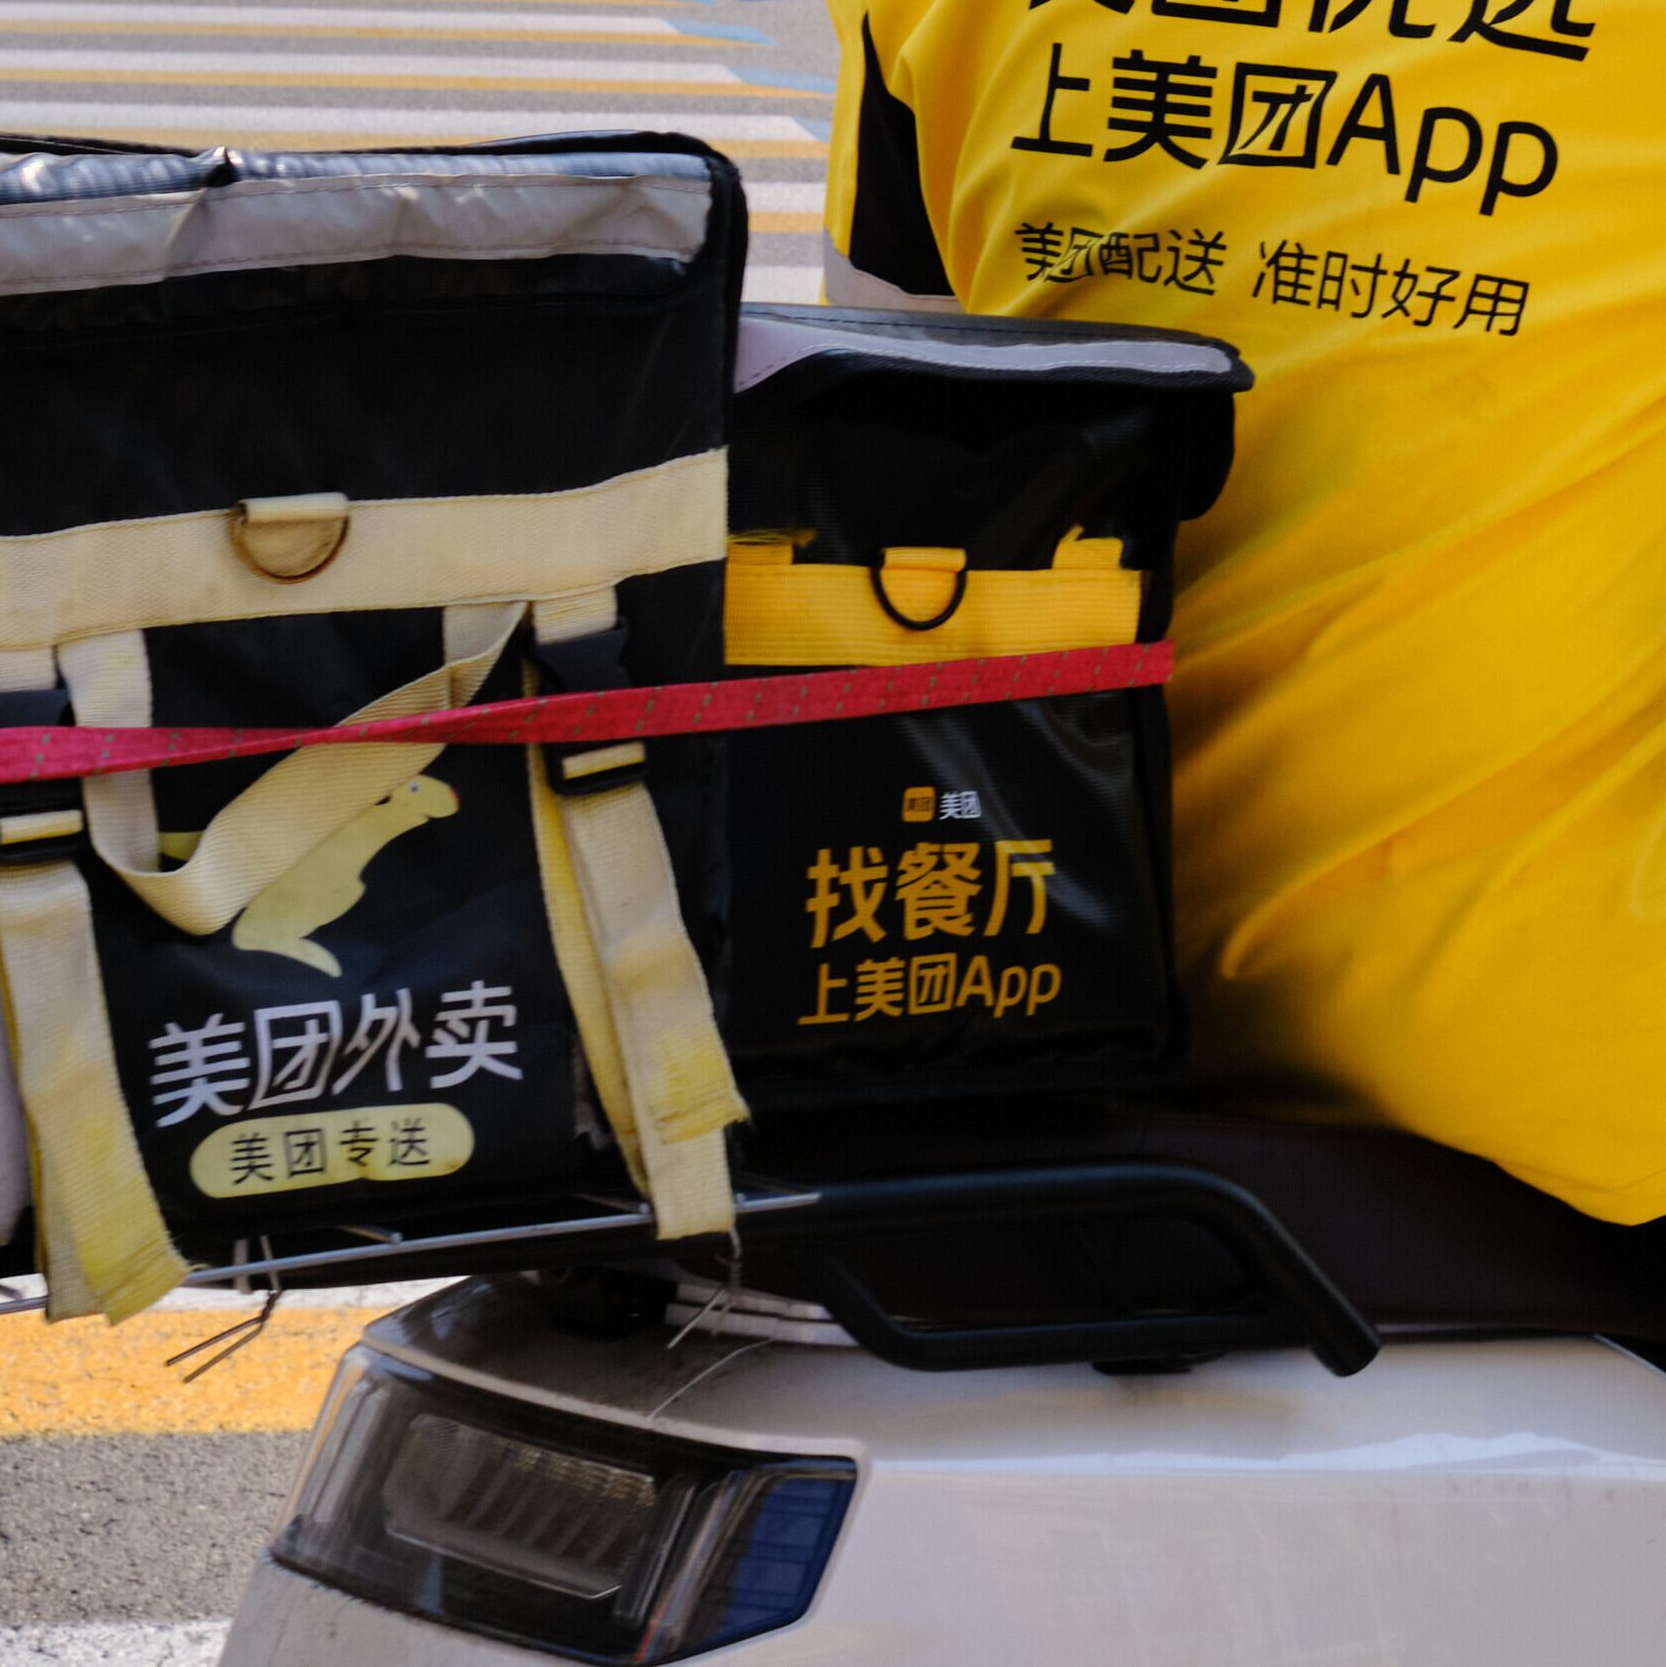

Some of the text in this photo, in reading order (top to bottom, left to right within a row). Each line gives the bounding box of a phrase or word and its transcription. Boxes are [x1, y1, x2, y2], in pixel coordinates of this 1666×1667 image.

[1010, 42, 1559, 216] 上美团App
[1251, 239, 1530, 337] 准时好用
[938, 790, 982, 820] 美团
[804, 838, 1055, 949] 找餐厅
[798, 952, 1062, 1025] 上美团App
[149, 980, 523, 1128] 美团外卖
[230, 1120, 431, 1185] 美团专送
